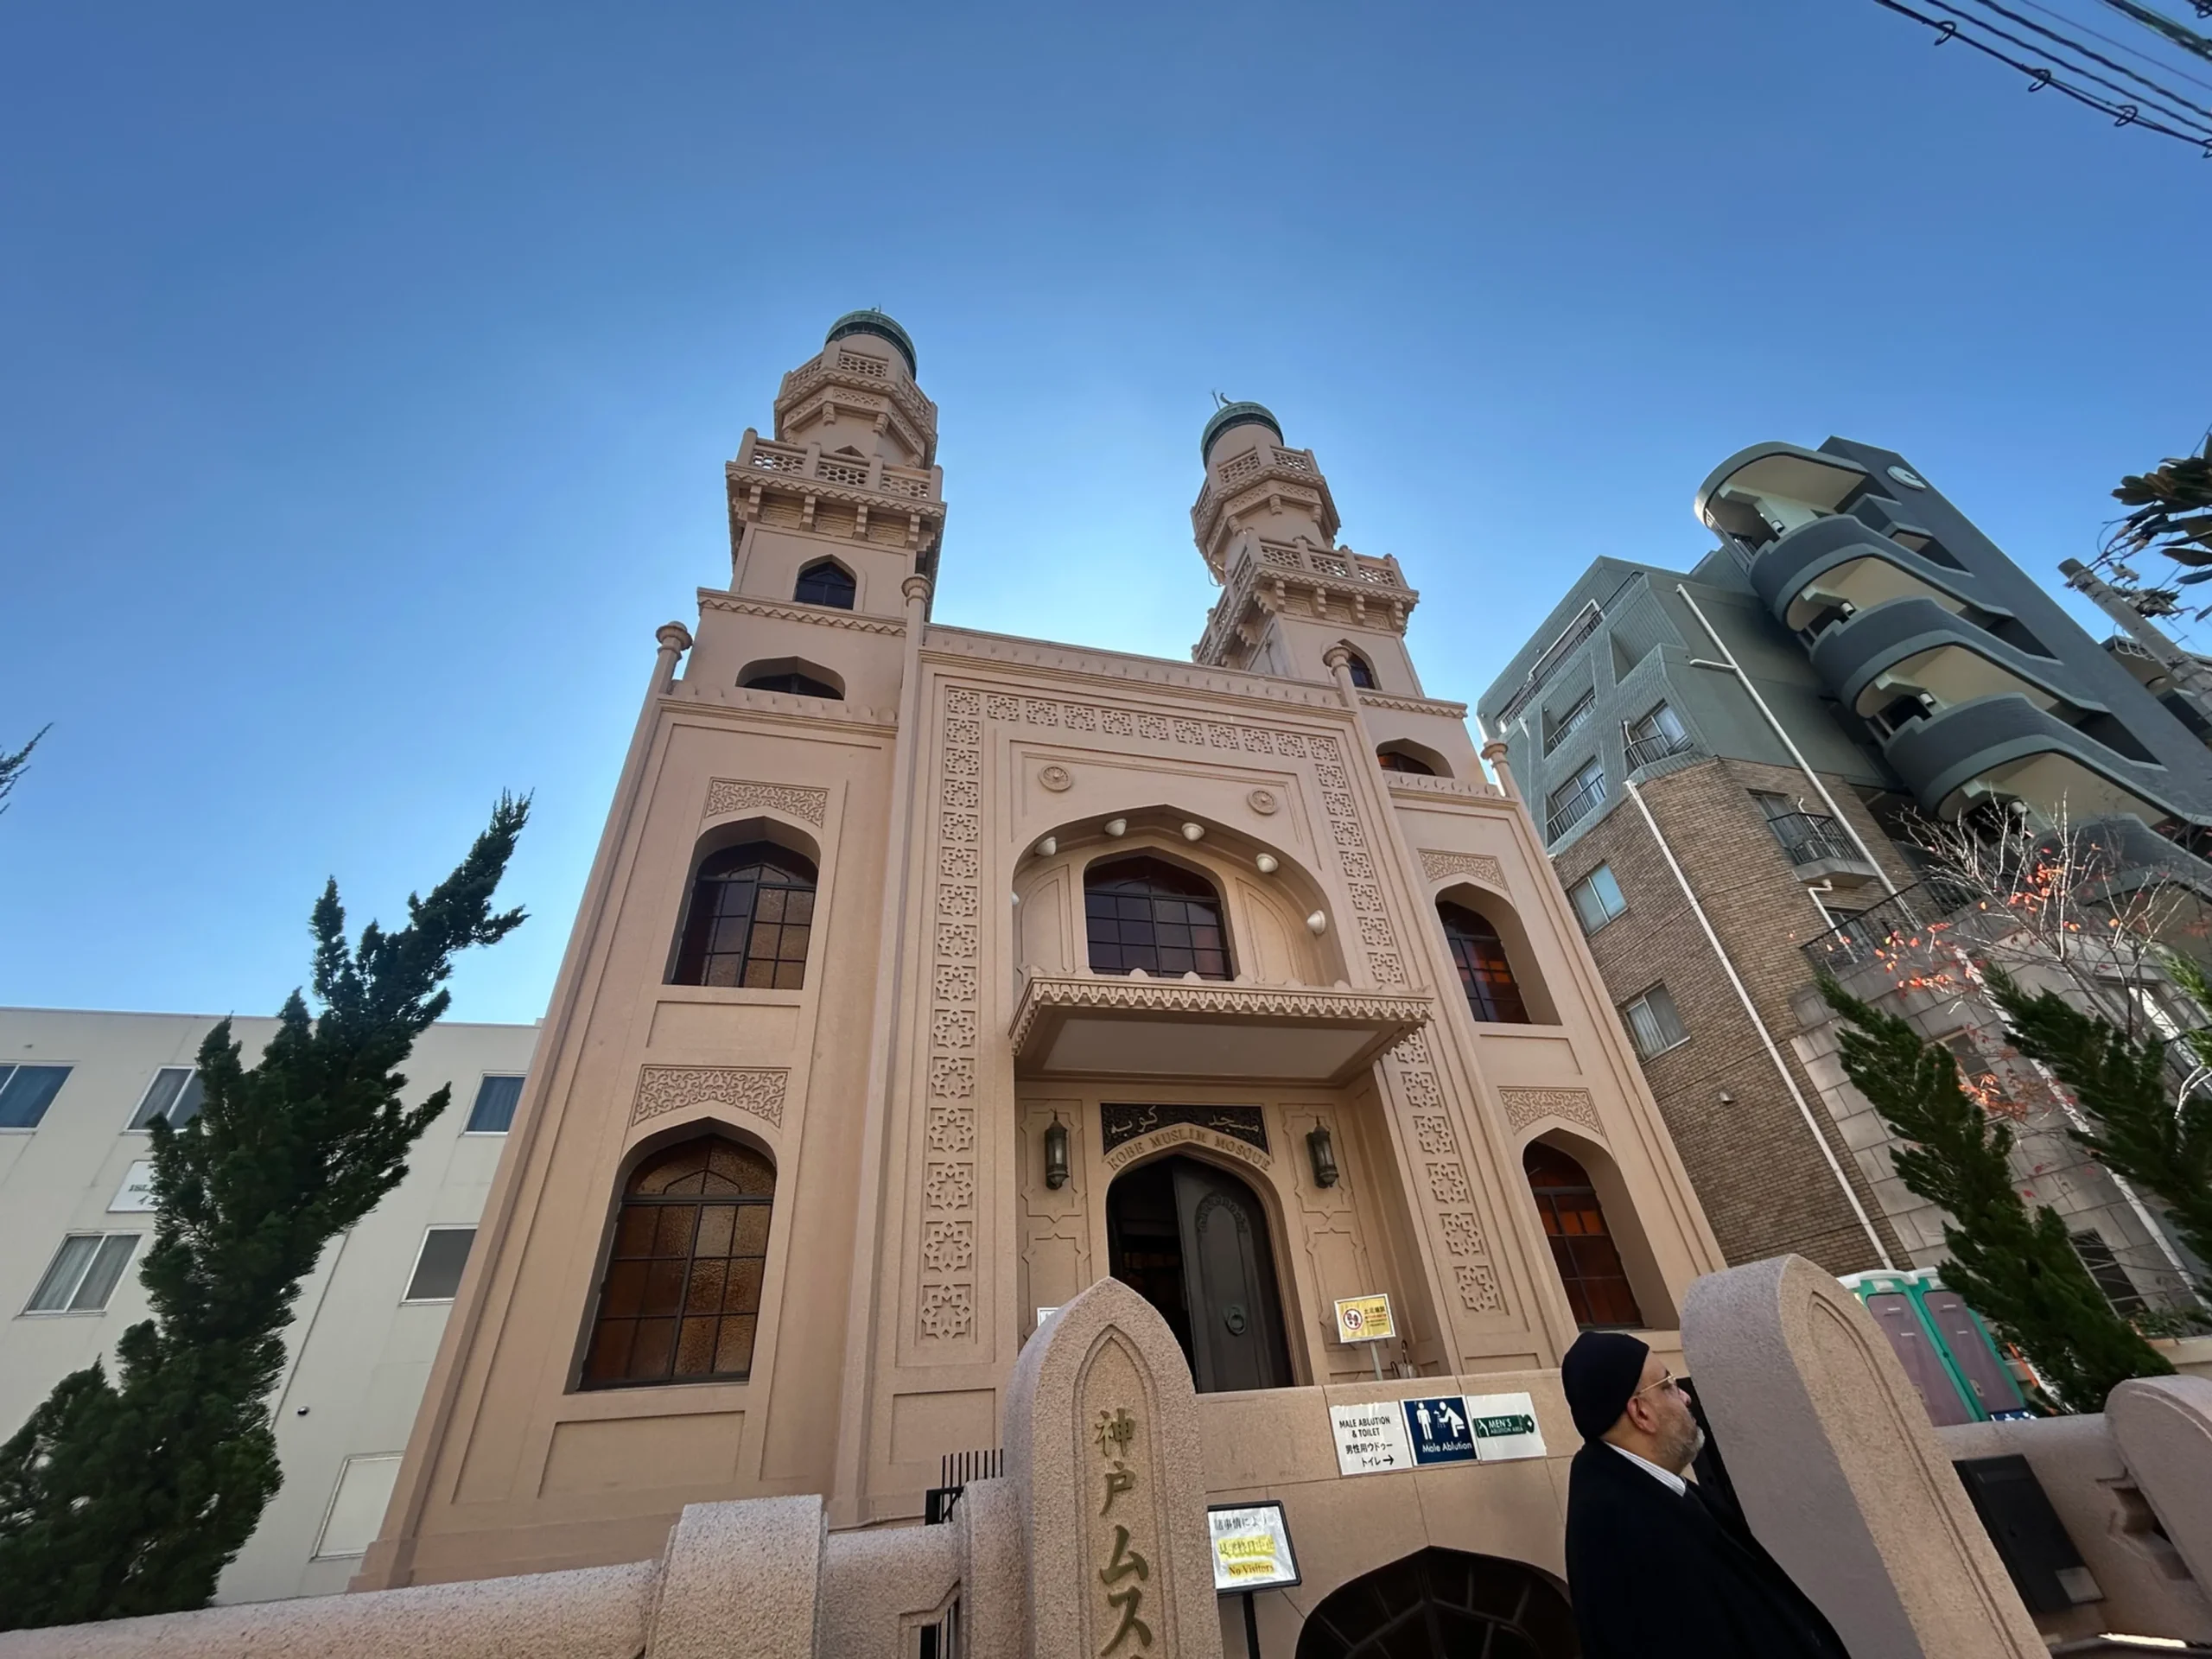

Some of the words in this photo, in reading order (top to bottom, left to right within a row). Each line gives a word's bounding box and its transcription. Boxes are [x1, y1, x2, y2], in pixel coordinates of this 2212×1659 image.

[1209, 1114, 1259, 1133] مسجد
[1107, 1141, 1146, 1171] KOBE
[1149, 1128, 1207, 1148] MUSLIM
[1214, 1135, 1271, 1172] MOSQUE
[1339, 1419, 1357, 1428] MALE
[1358, 1415, 1391, 1427] ABLUTION
[1351, 1430, 1357, 1439] &
[1358, 1427, 1381, 1438] TOILET
[1422, 1443, 1441, 1453] Male
[1442, 1440, 1472, 1452] Ablution
[1361, 1456, 1382, 1468] トイレ
[1094, 1408, 1153, 1659] 神戸ムス
[1229, 1565, 1242, 1576] No
[1243, 1562, 1274, 1573] Visitors
